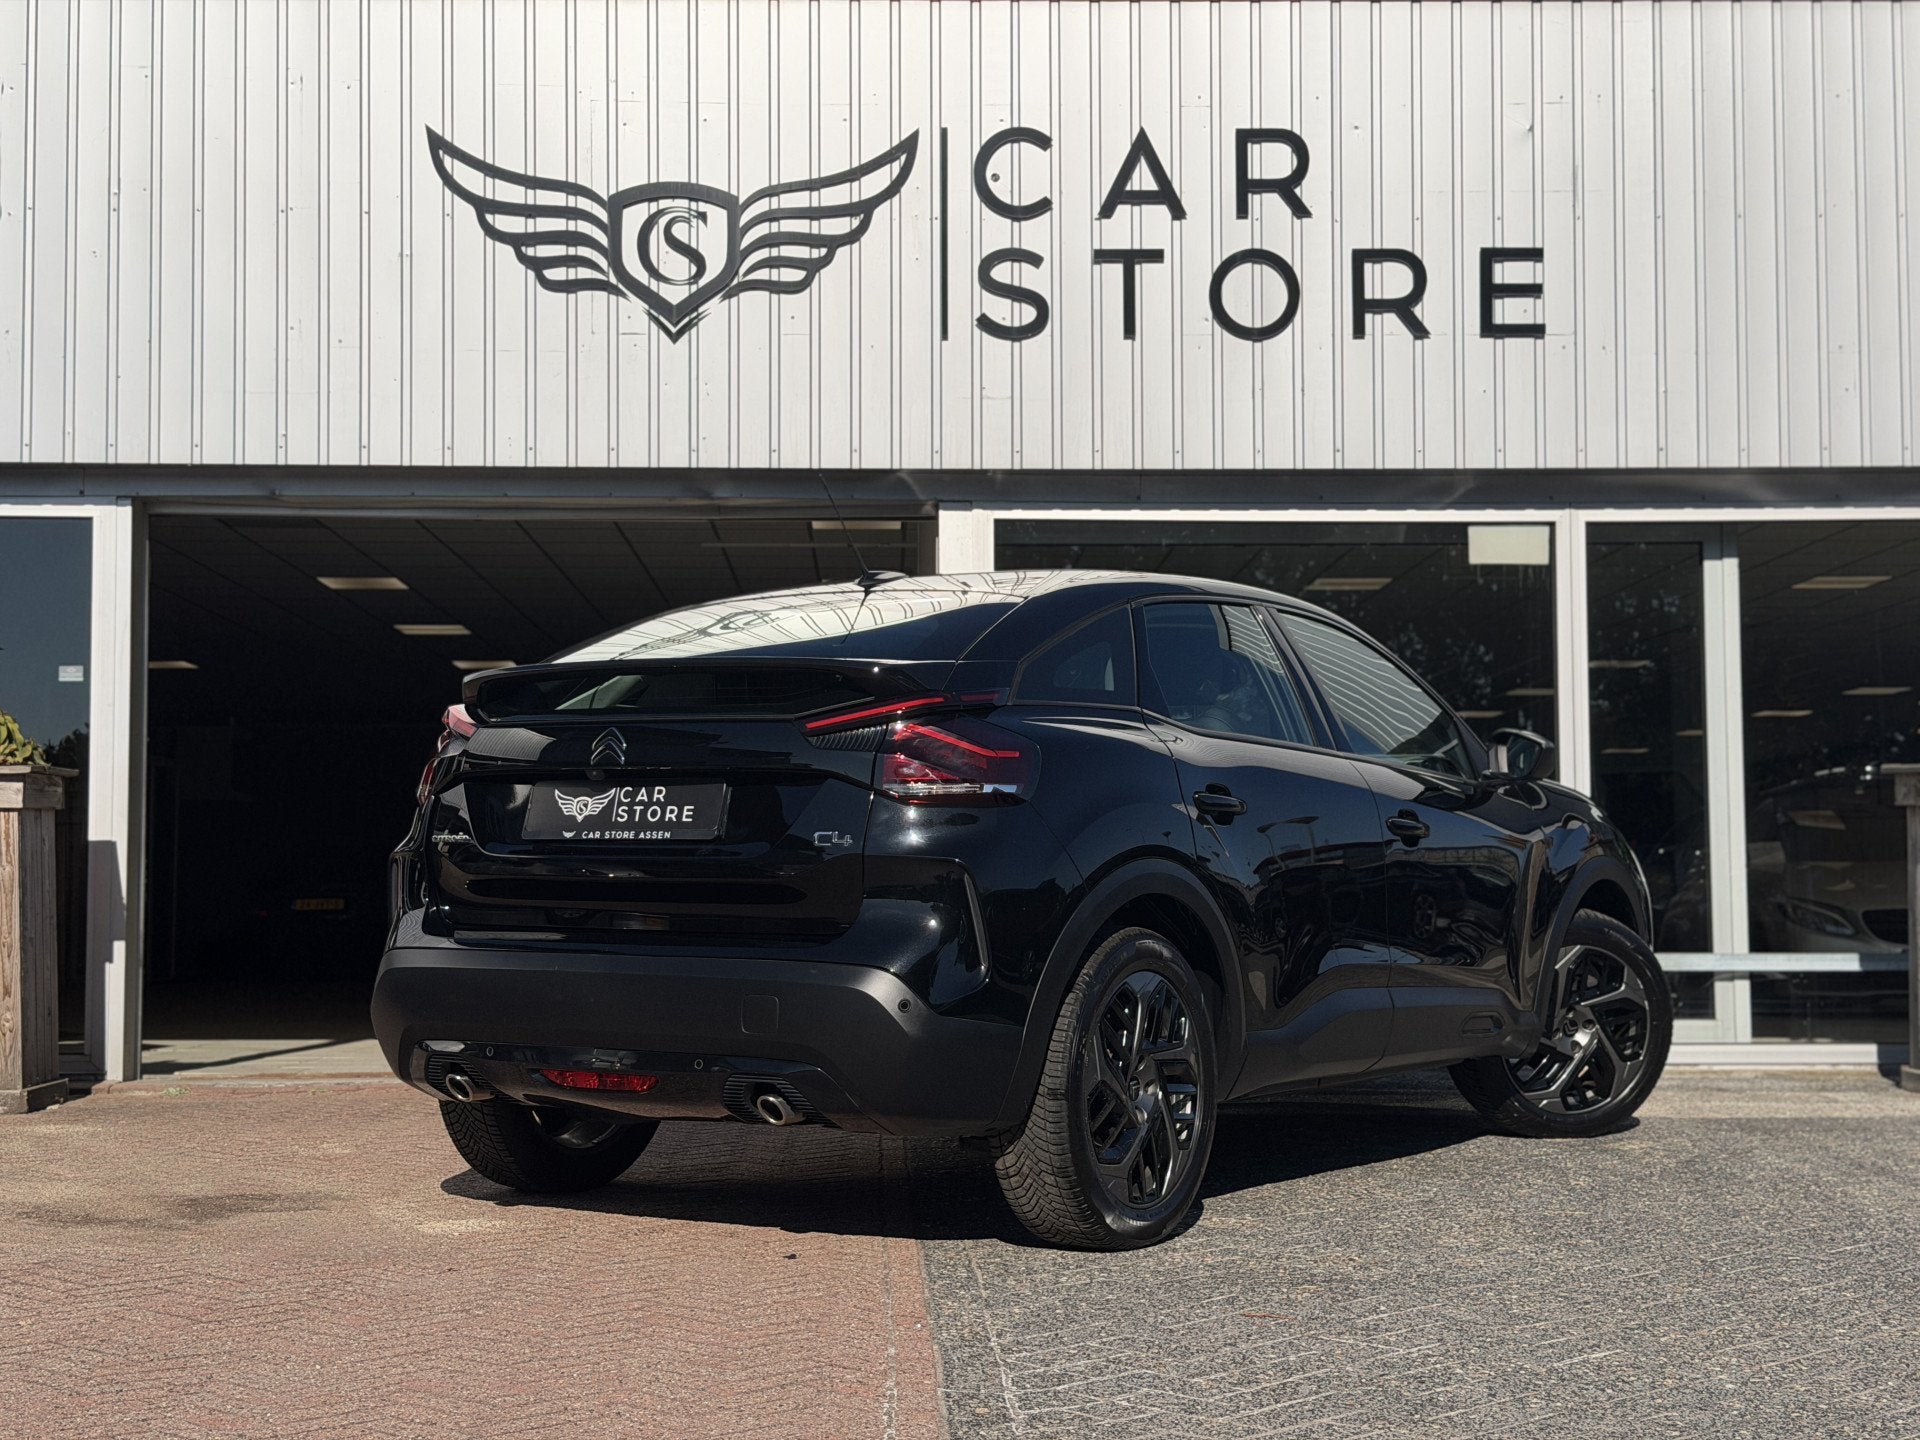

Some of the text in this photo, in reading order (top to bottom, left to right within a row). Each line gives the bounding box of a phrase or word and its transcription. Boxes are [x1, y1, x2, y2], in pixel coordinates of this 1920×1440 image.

[976, 128, 1311, 222] CAR
[978, 248, 1547, 343] STORE
[620, 786, 667, 803] CAR
[616, 804, 695, 822] STORE
[581, 830, 671, 839] CAR STORE ASSEN
[813, 831, 853, 847] C4
